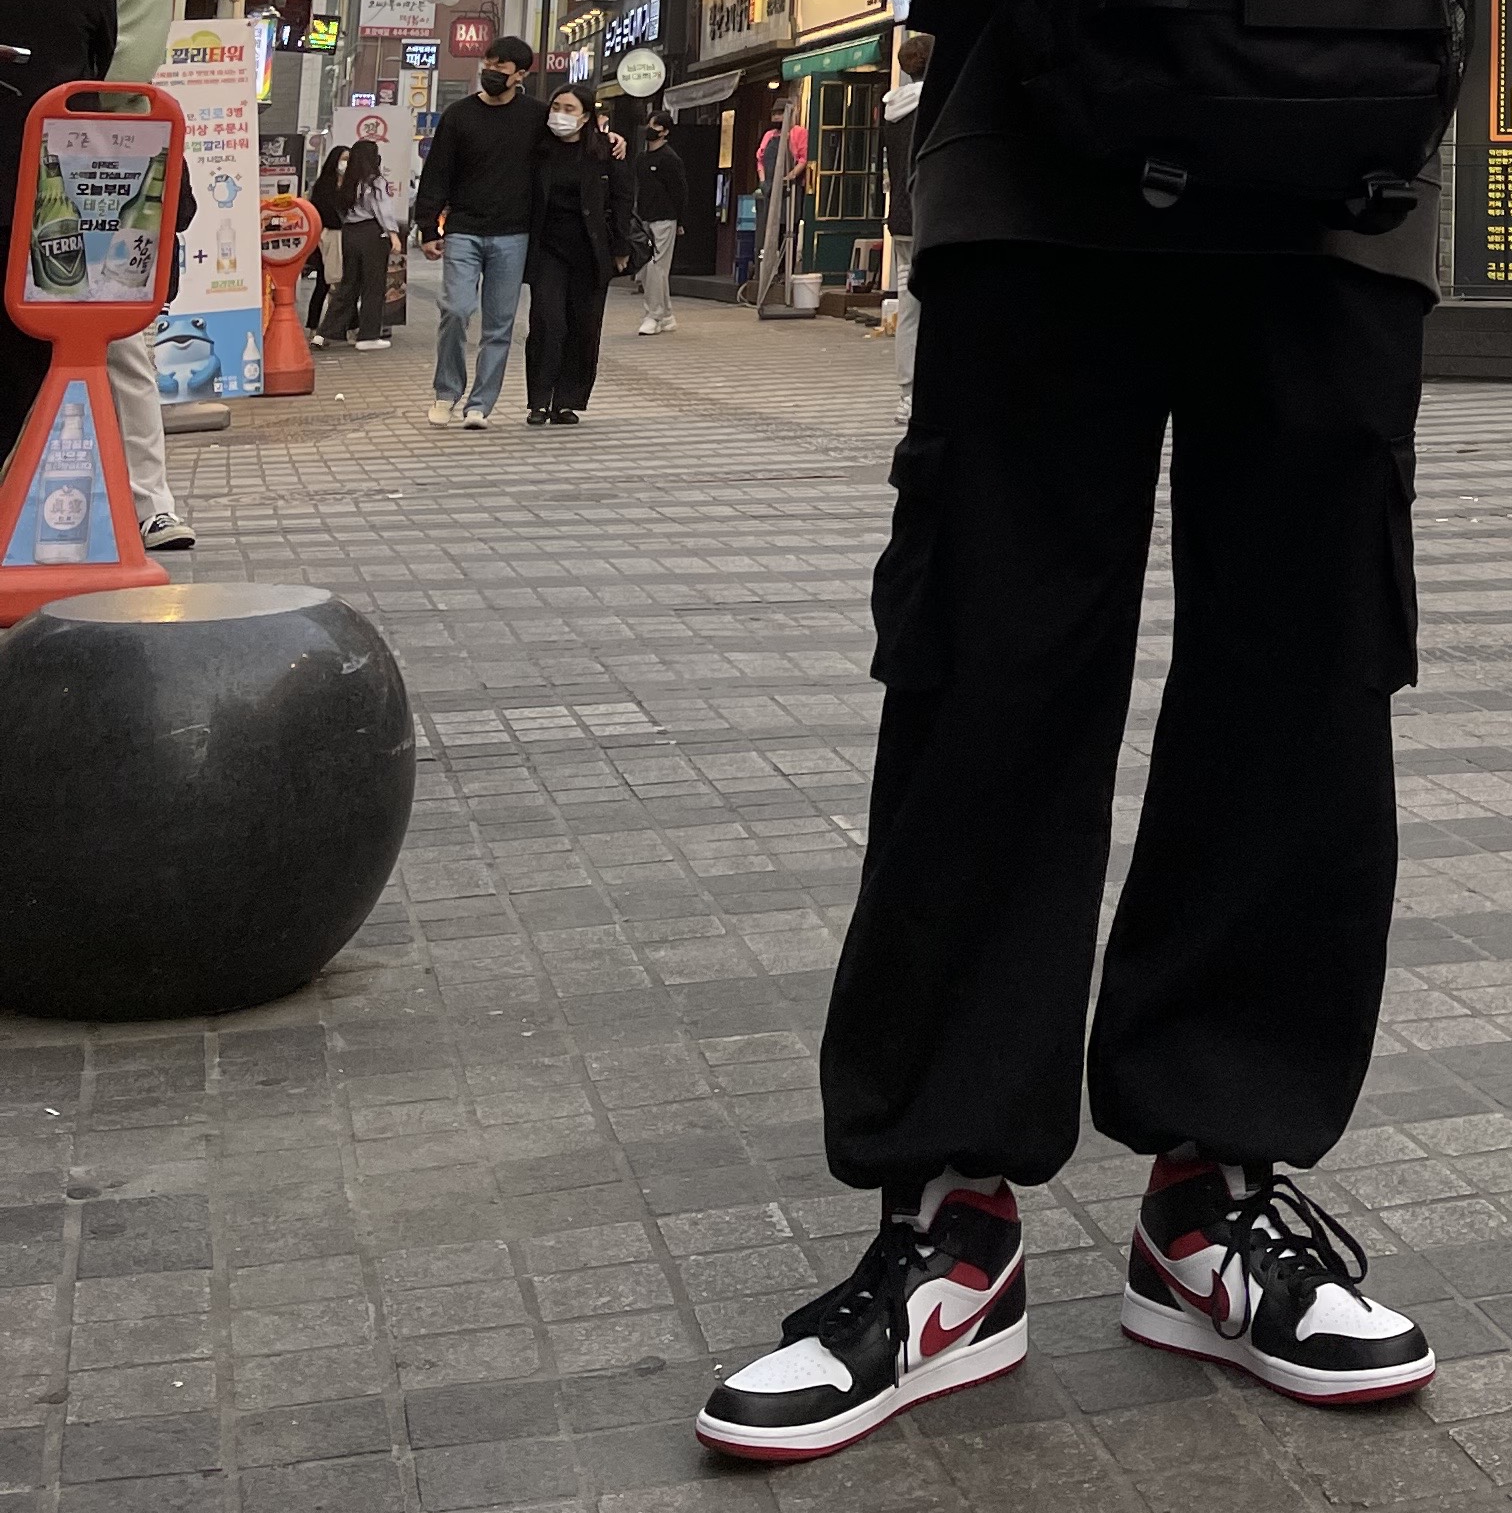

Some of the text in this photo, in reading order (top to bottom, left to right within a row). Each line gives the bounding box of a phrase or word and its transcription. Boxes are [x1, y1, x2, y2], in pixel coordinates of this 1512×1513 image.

[456, 23, 489, 41] BAR
[184, 138, 250, 153] 껍깔라타워
[76, 183, 131, 197] 오늘부터
[83, 198, 121, 217] 테슬라
[41, 235, 84, 257] TERRA
[133, 235, 153, 257] 참
